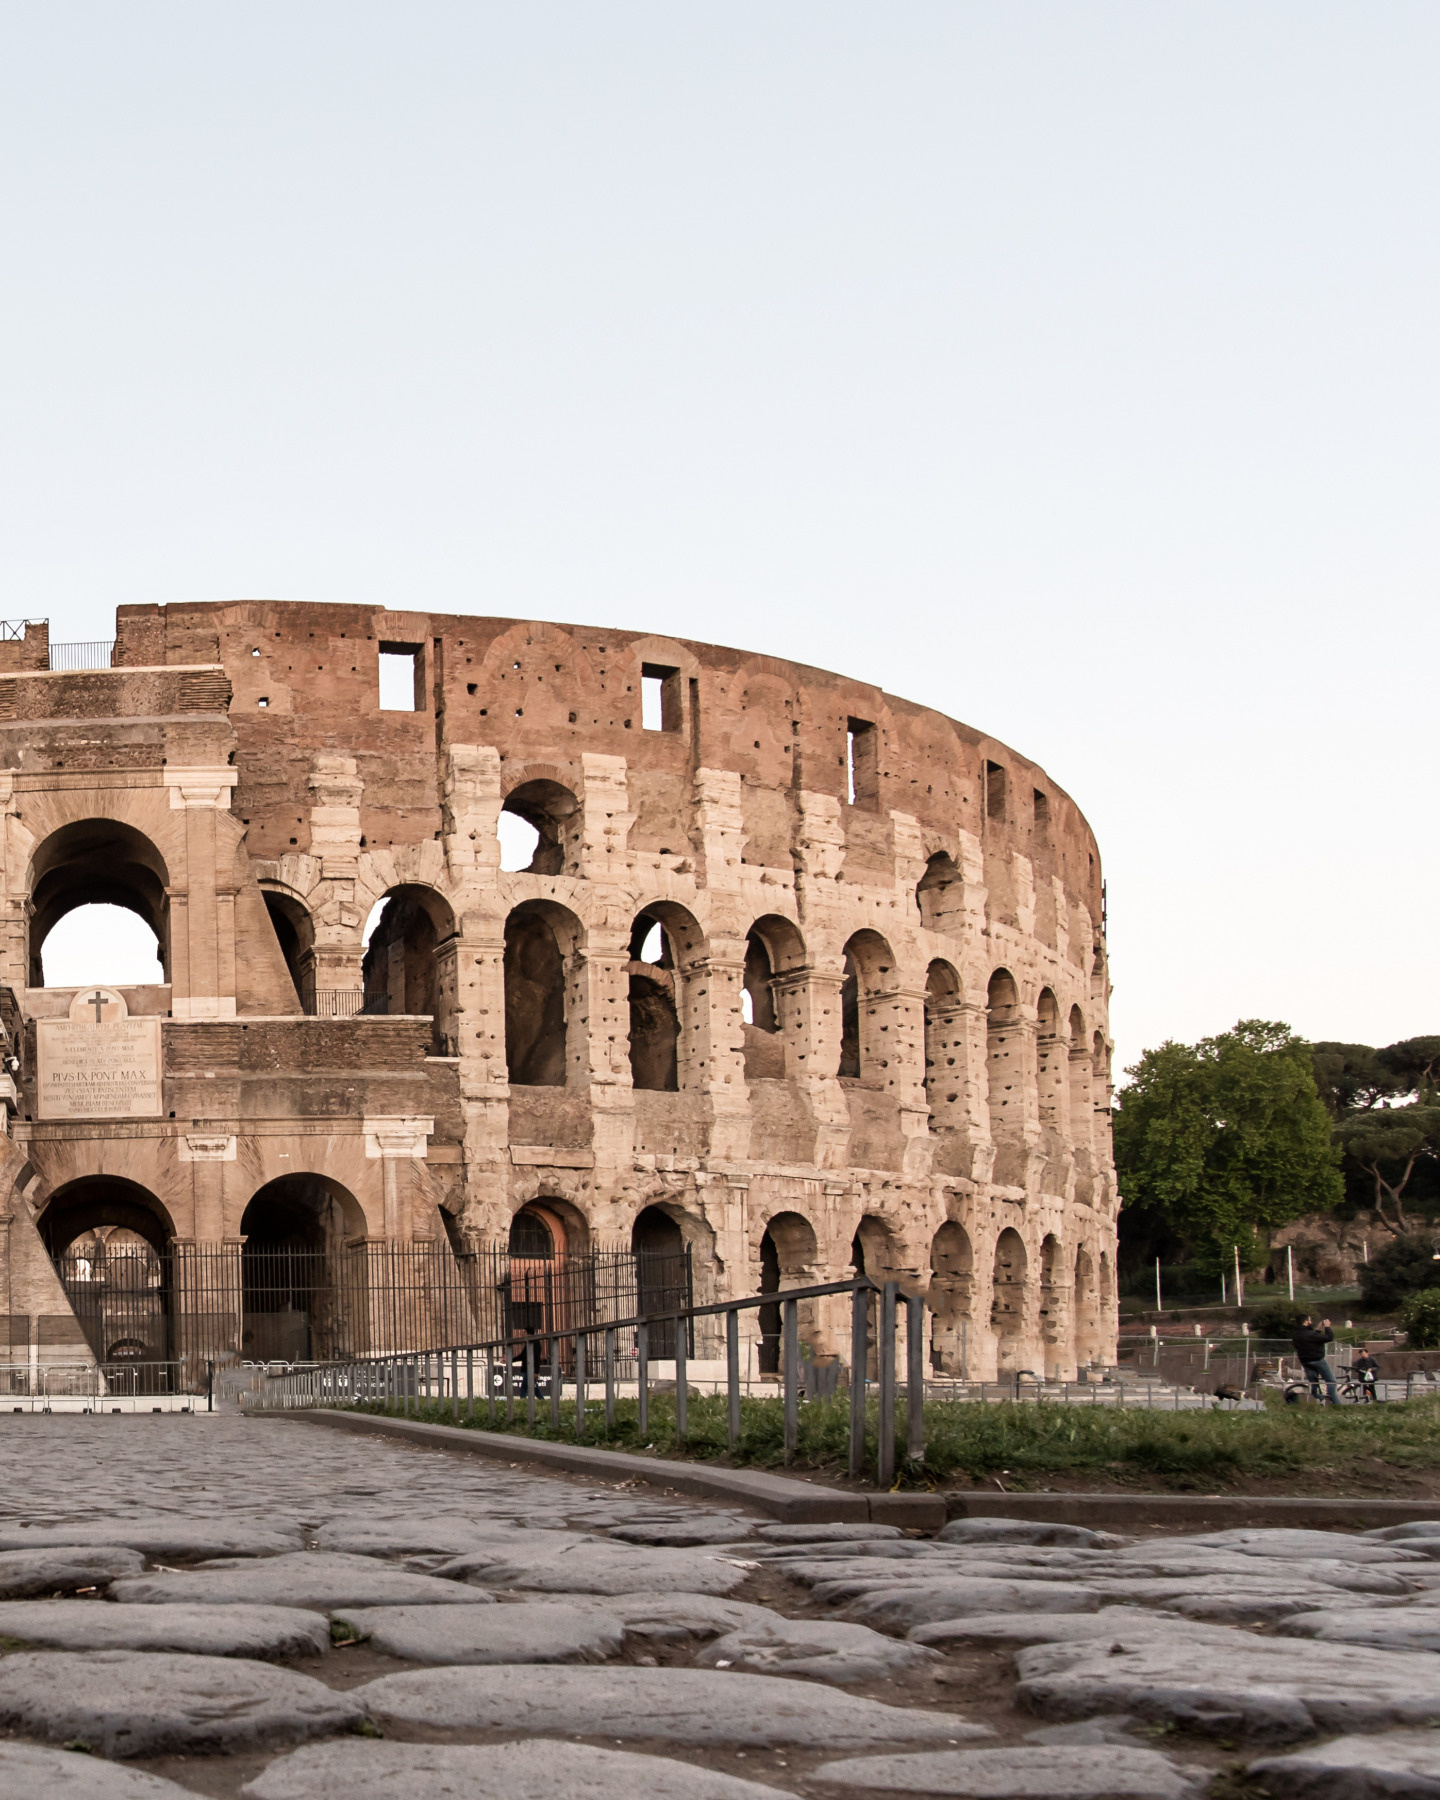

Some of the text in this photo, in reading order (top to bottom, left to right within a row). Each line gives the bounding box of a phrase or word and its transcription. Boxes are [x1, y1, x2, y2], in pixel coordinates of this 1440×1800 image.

[52, 1070, 146, 1081] PIVS IX PONT MAX
